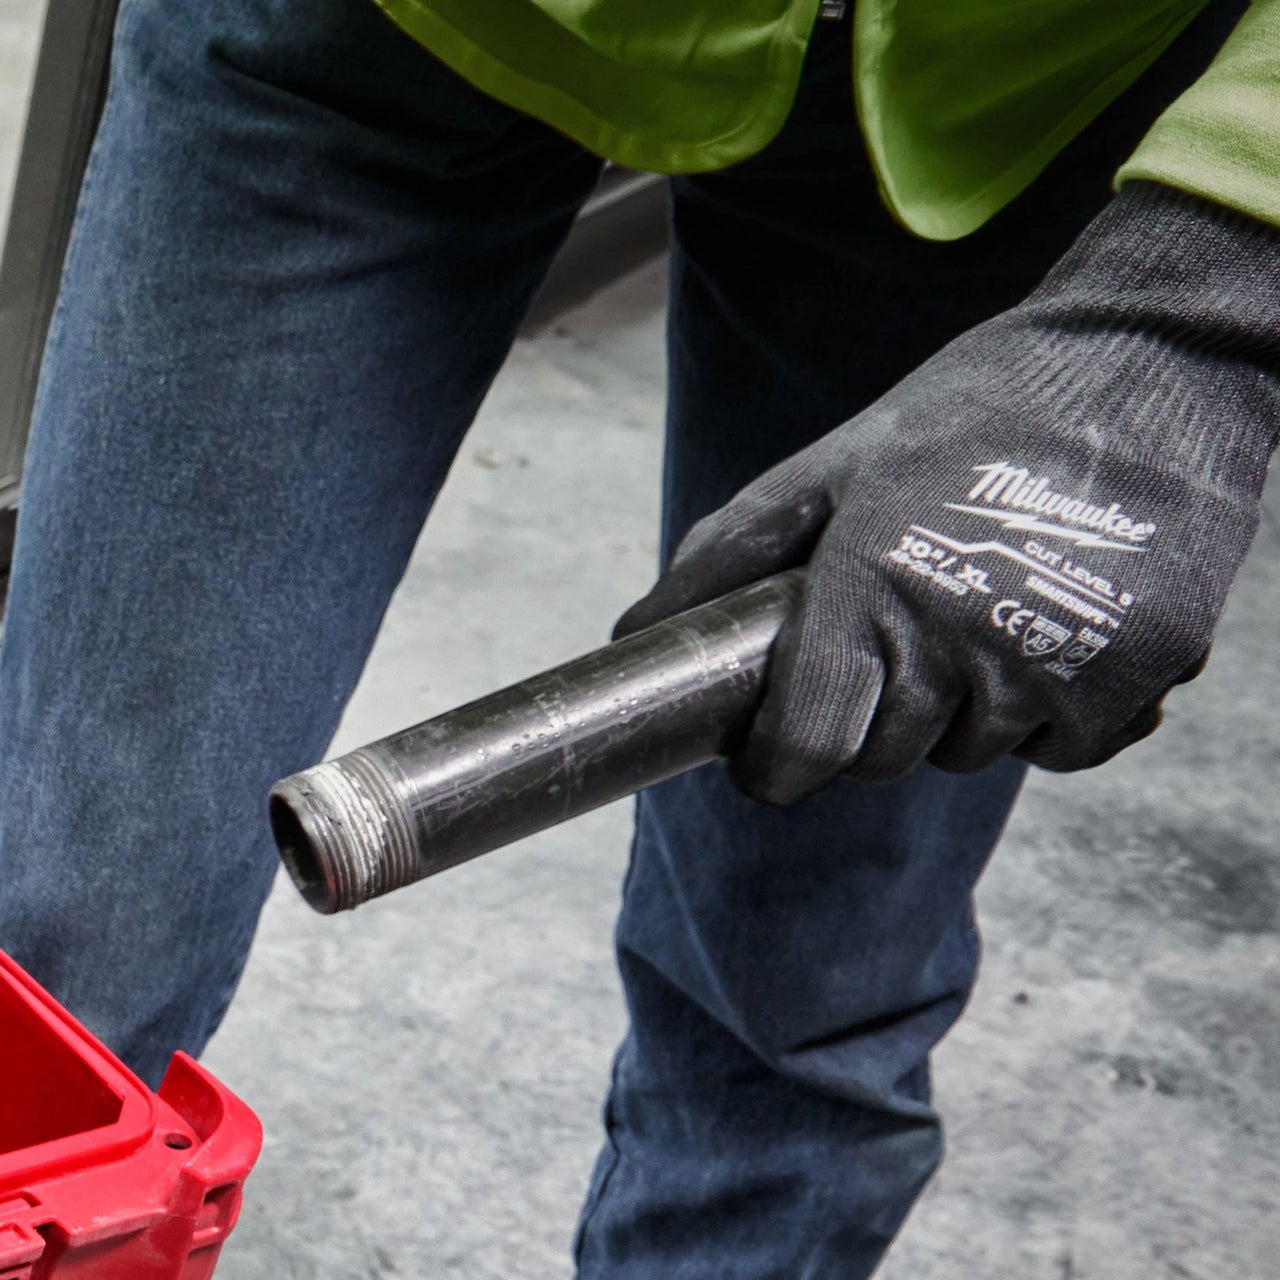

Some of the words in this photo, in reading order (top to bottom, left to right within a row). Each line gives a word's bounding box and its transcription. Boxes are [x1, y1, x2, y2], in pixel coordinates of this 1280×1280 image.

[967, 461, 1154, 541] Milwaukee
[955, 563, 992, 593] XL
[1024, 541, 1061, 565] CUT
[1062, 561, 1116, 598] LEVEL
[1119, 592, 1133, 606] 5
[1026, 633, 1052, 651] A5
